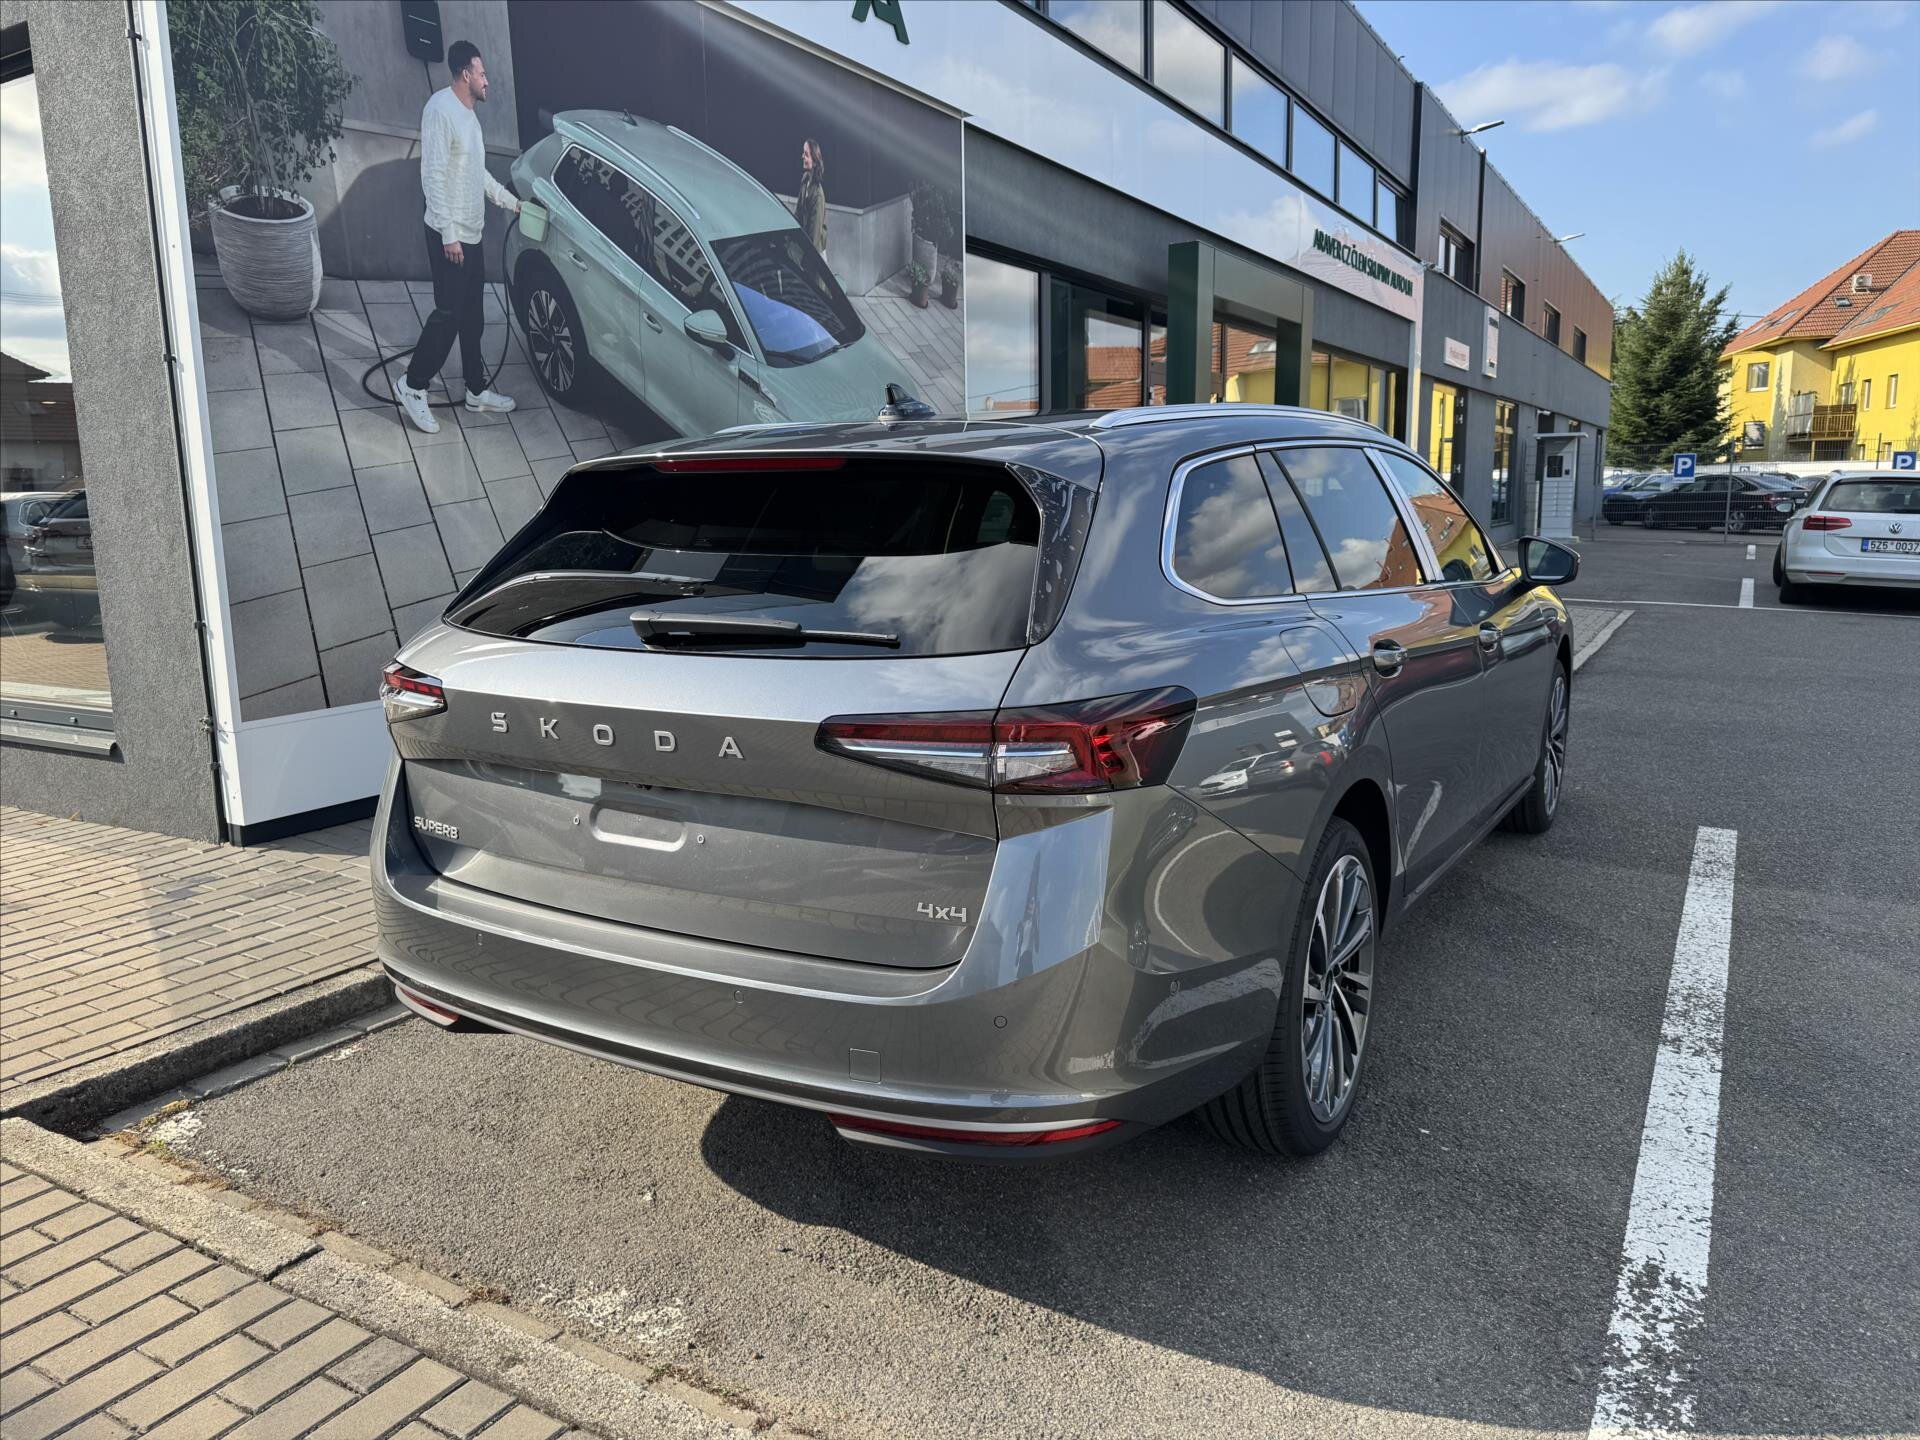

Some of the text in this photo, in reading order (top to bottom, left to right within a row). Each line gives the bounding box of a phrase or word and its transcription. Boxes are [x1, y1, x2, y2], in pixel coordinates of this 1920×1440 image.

[1677, 458, 1692, 474] P
[1896, 455, 1912, 469] P
[1871, 540, 1888, 550] 5Z5
[490, 711, 744, 759] SKODA
[414, 816, 458, 839] SUPERB
[916, 902, 967, 923] 4x4
